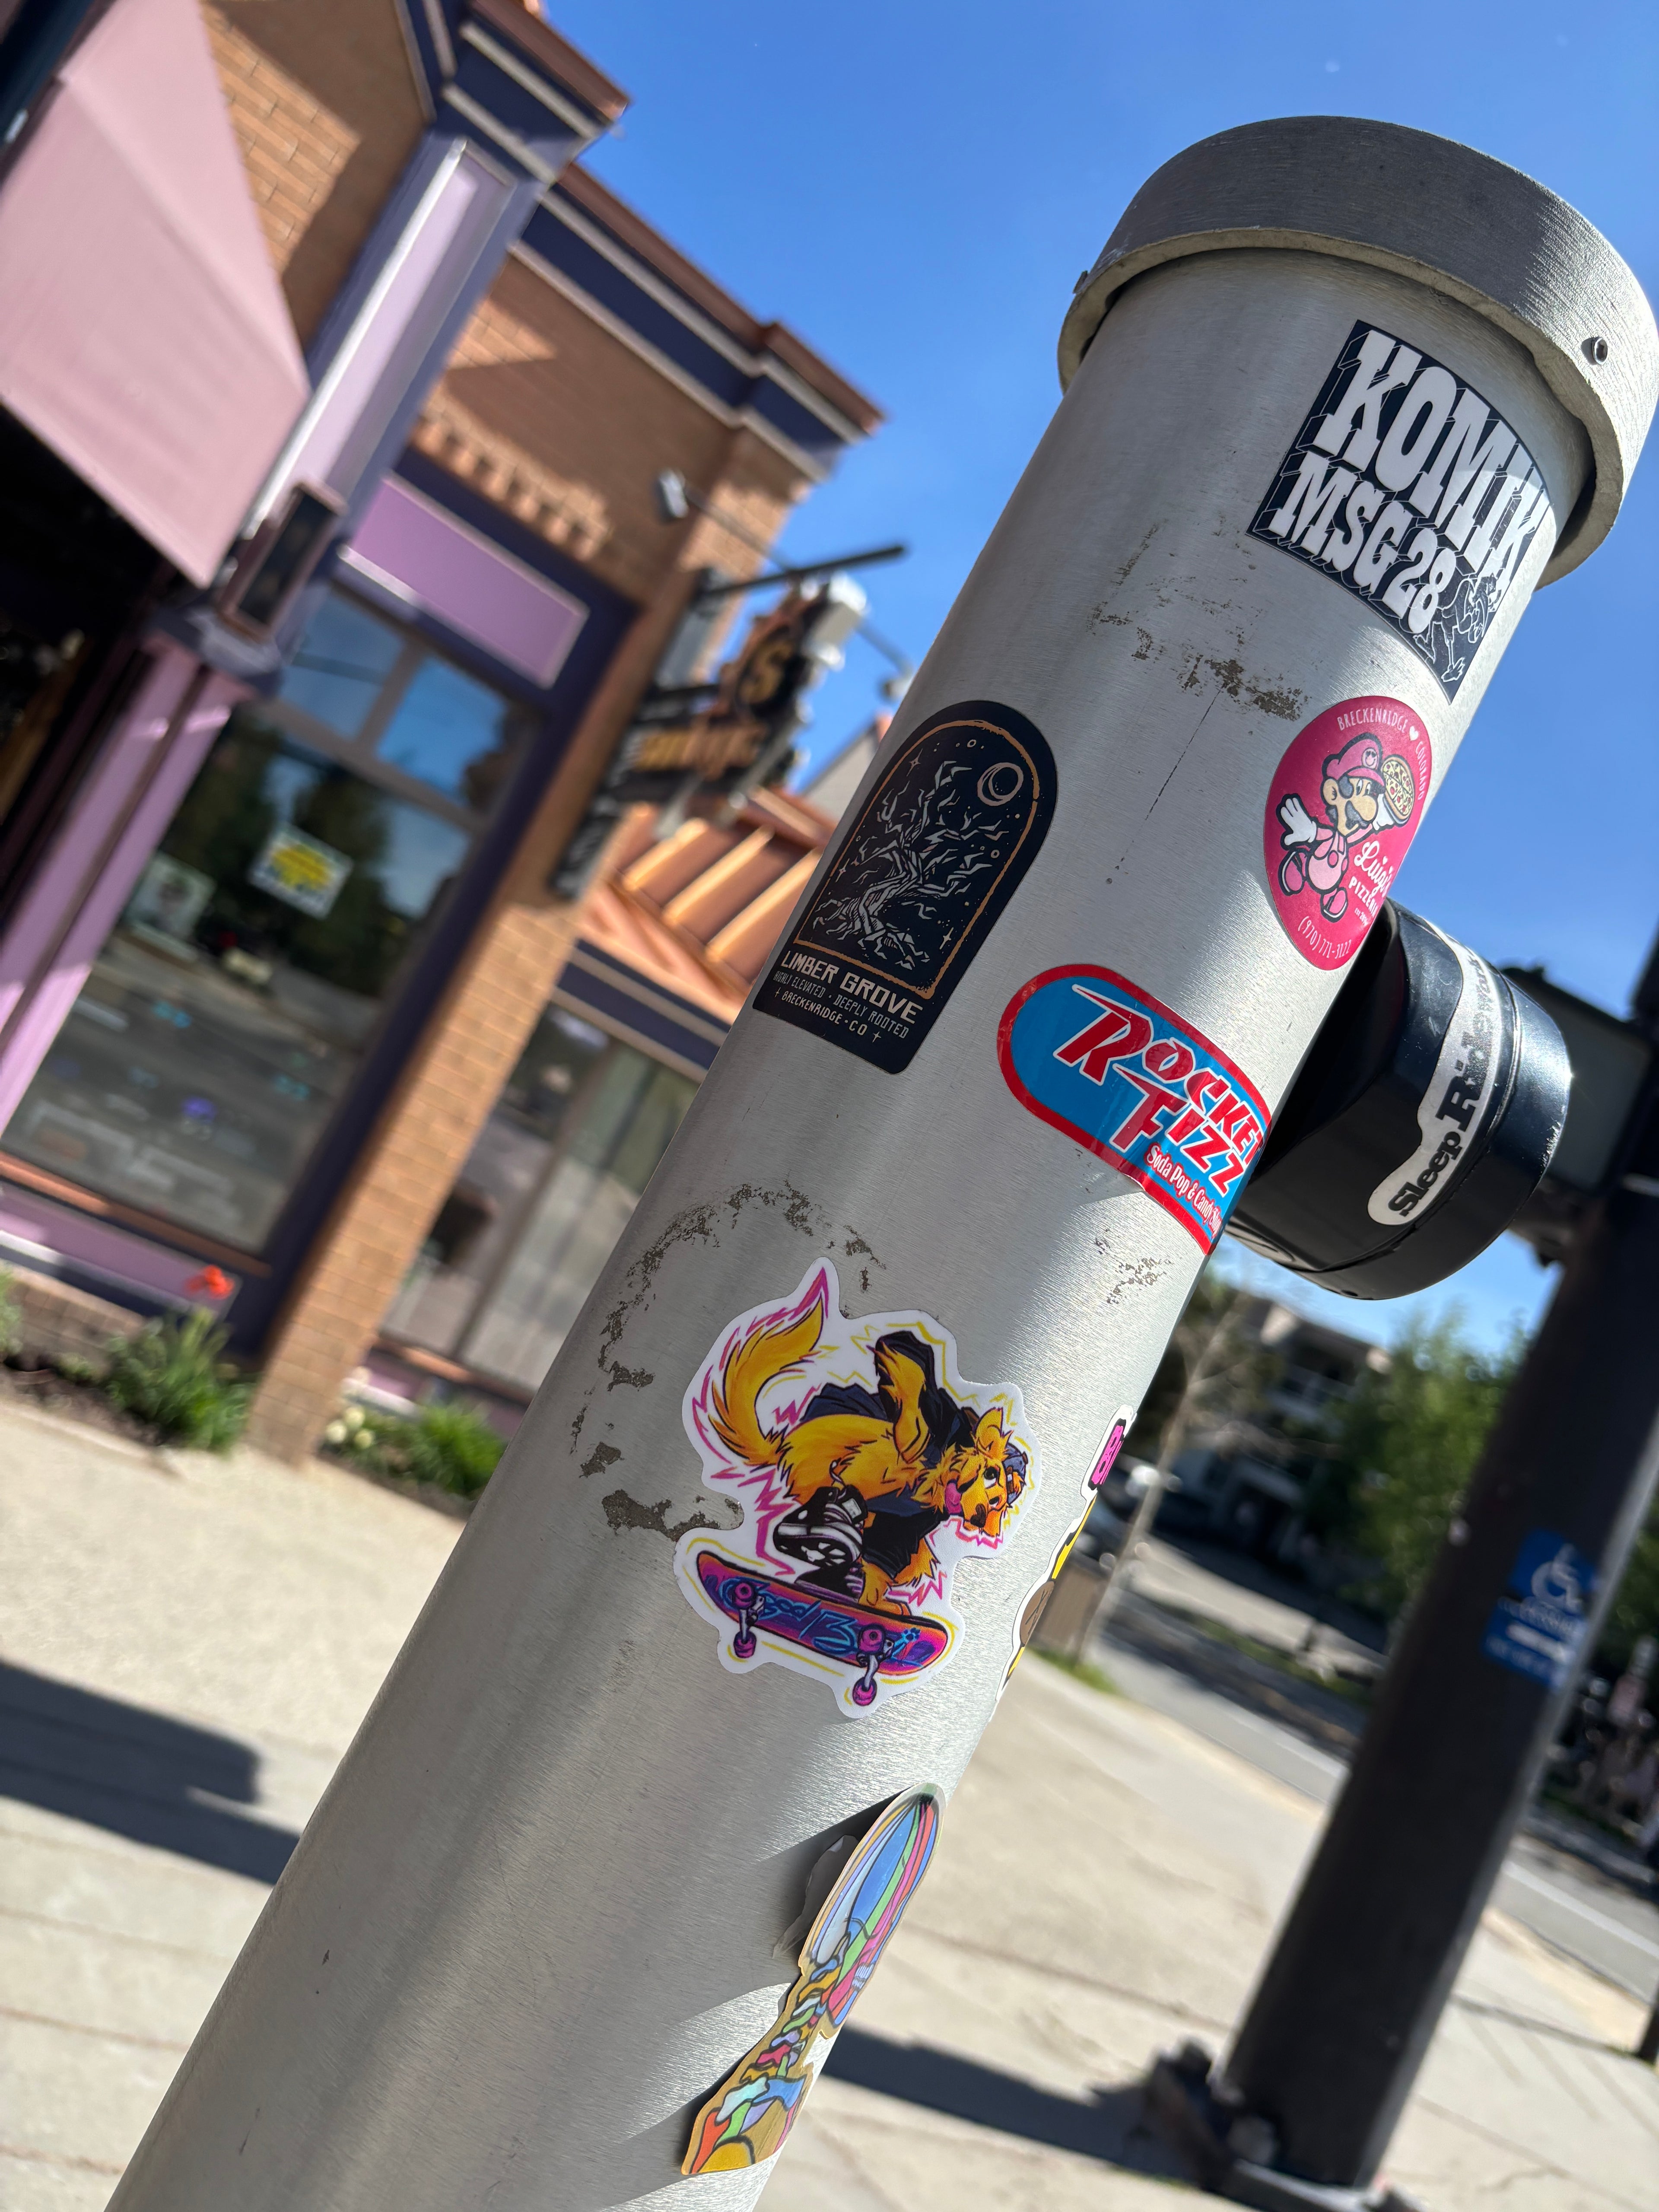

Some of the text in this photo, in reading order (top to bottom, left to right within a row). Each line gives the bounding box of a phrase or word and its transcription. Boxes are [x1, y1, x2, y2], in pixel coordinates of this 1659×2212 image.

[1300, 330, 1550, 605] KOMIK
[1264, 452, 1457, 634] MSG28
[1337, 708, 1408, 733] BRECKENRIDGE
[1415, 741, 1427, 800] COLORADO
[1348, 876, 1378, 918] PIZZERIA
[1354, 840, 1392, 897] Luigi's
[1298, 916, 1321, 950] (970)
[772, 970, 909, 1039] HIGHLY ELEVATED DEEPLY ROOTED
[780, 950, 923, 1024] LIMBER GROVE
[781, 990, 843, 1025] BRECKENRIDGE
[1053, 983, 1264, 1166] ROCKET
[1109, 1063, 1246, 1198] FIZZ
[1147, 1145, 1173, 1178] Soda
[1169, 1165, 1190, 1196] Pop
[1186, 1182, 1199, 1200] &
[1193, 1189, 1214, 1222] Candy
[1388, 1131, 1462, 1217] Sleep
